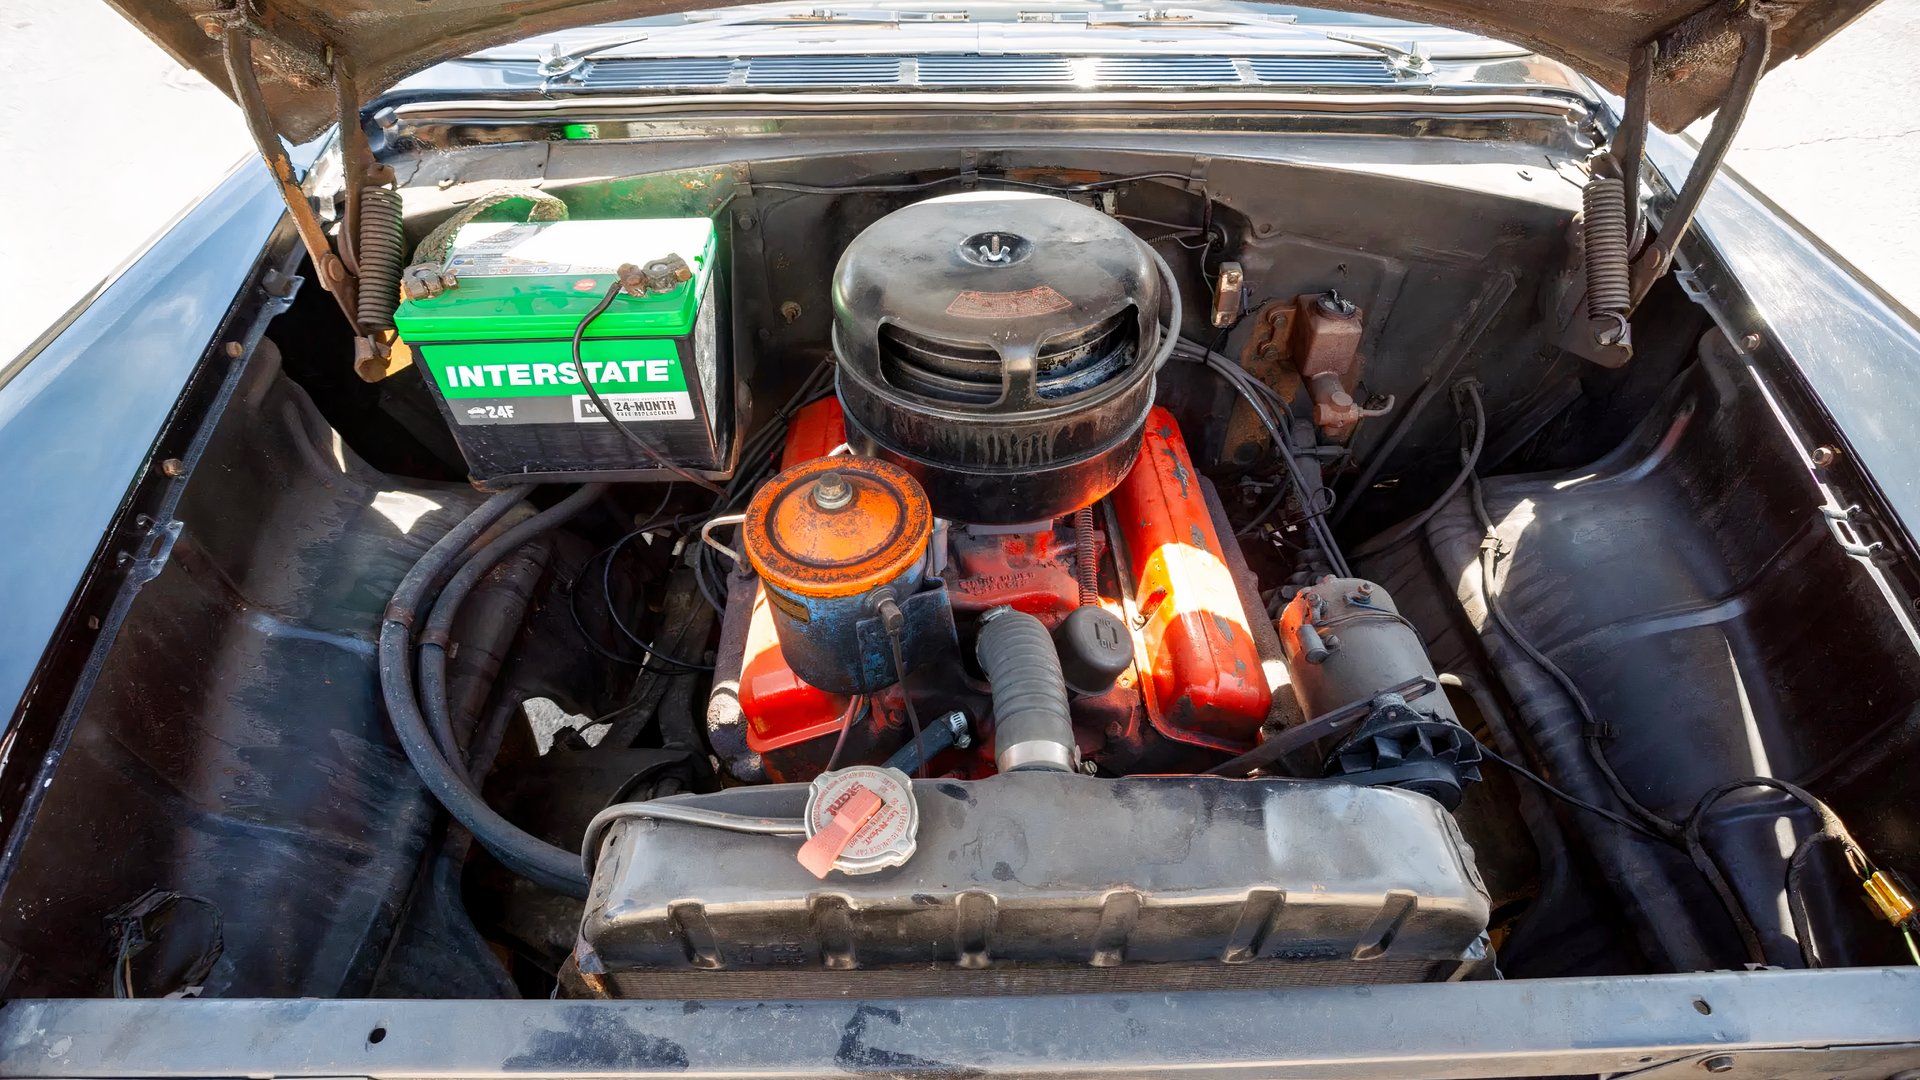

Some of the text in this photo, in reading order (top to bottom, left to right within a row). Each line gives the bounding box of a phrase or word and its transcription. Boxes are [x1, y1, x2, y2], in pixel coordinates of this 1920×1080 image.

[445, 359, 670, 388] INTERSTATE
[485, 405, 515, 419] 24F
[613, 400, 677, 412] 24-MONTH
